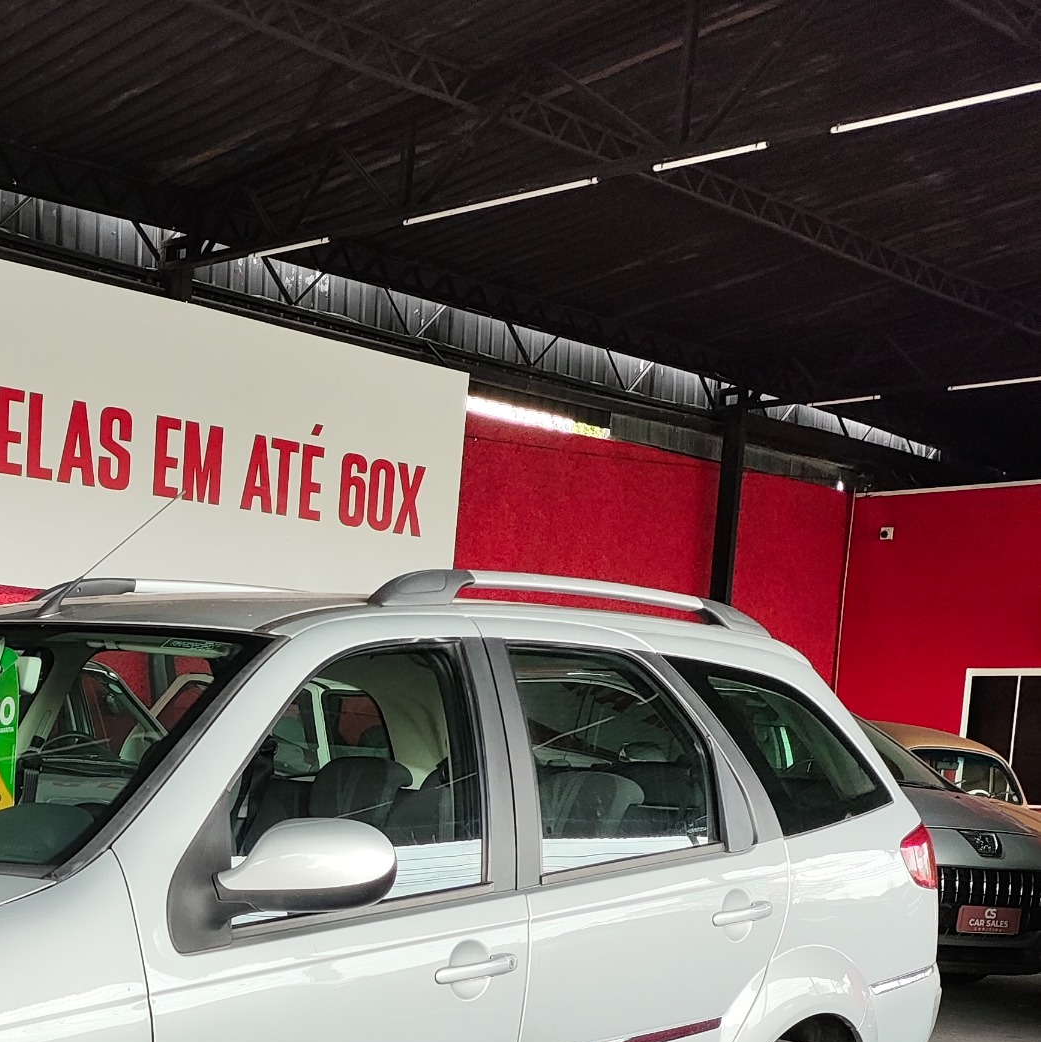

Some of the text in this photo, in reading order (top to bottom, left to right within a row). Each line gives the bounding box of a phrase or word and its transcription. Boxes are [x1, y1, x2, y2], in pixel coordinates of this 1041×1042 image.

[152, 415, 225, 506] EM
[239, 423, 326, 522] ATÉ
[338, 452, 426, 538] 60X
[969, 919, 1008, 928] CAR SALES
